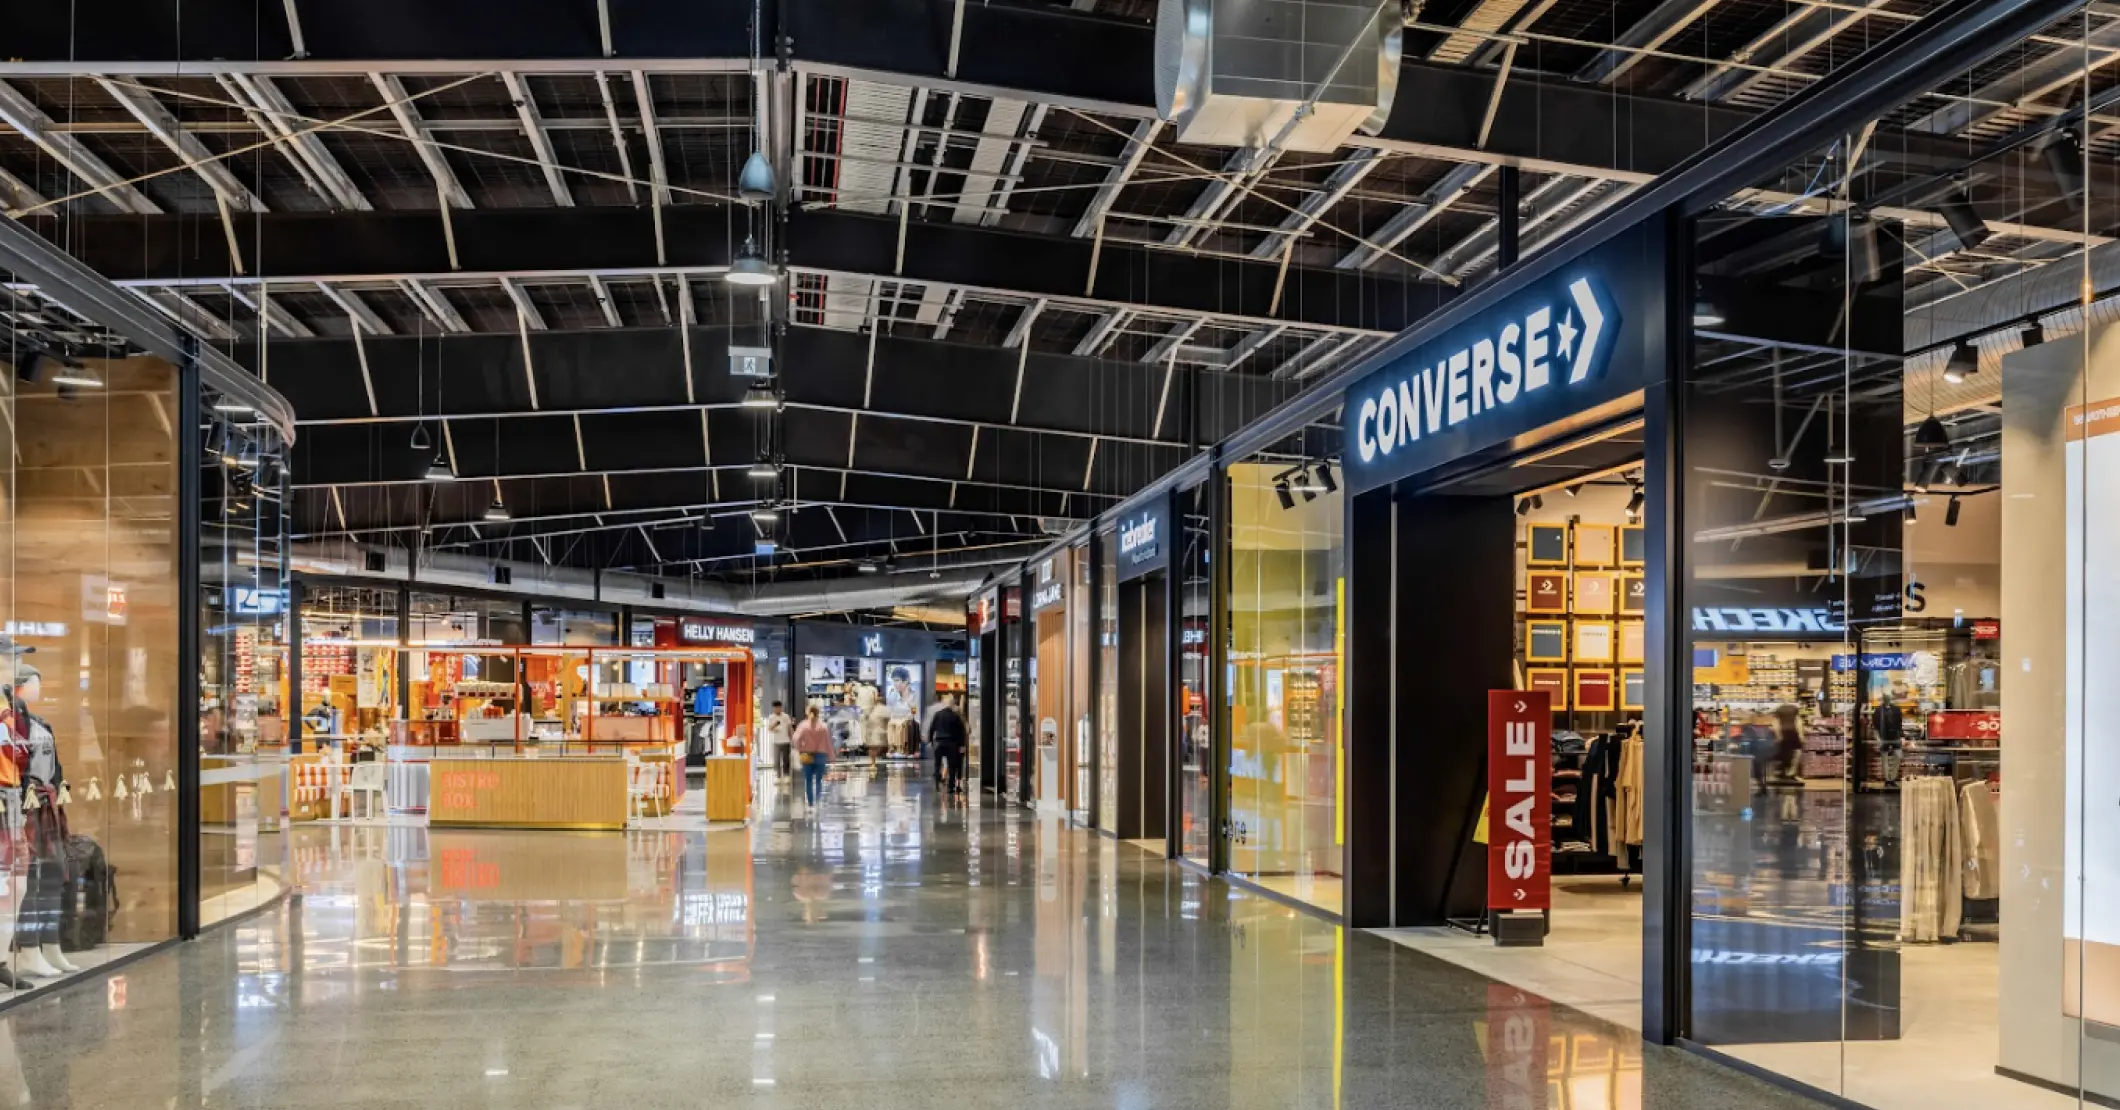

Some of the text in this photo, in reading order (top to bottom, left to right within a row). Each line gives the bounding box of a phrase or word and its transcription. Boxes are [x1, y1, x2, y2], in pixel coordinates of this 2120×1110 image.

[1358, 305, 1552, 463] CONVERSE
[684, 623, 754, 643] HELLY HANSEN
[441, 771, 500, 789] BISTRO
[1504, 720, 1536, 880] SALE
